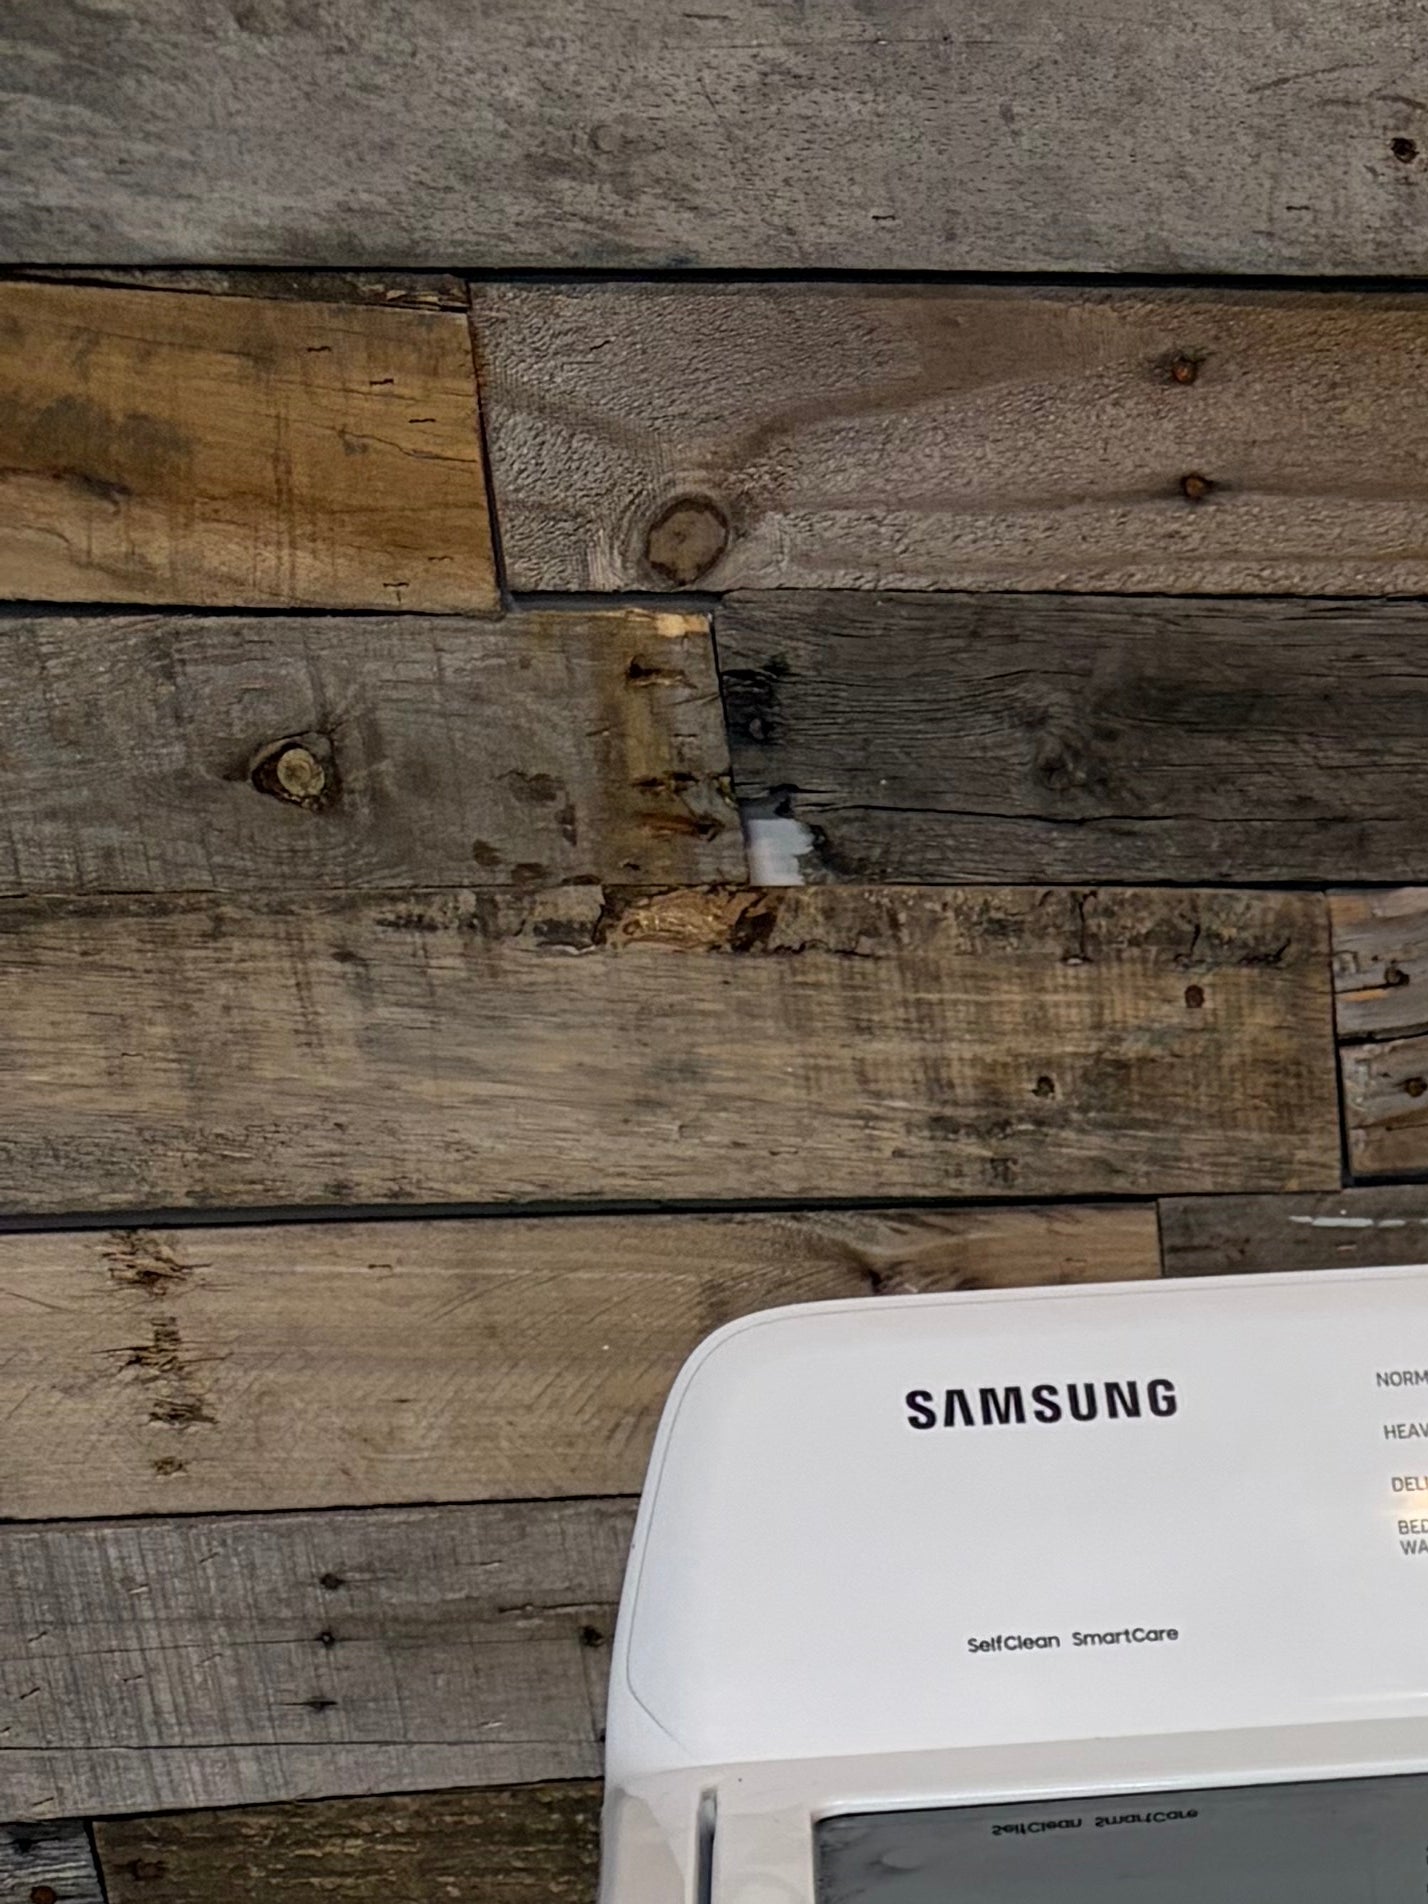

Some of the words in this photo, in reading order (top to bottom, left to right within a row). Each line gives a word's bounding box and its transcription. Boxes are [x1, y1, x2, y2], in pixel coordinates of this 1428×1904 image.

[904, 1377, 1179, 1431] SAMSUNG
[967, 1633, 1061, 1653] SelfClean
[1071, 1626, 1180, 1648] SmartCare
